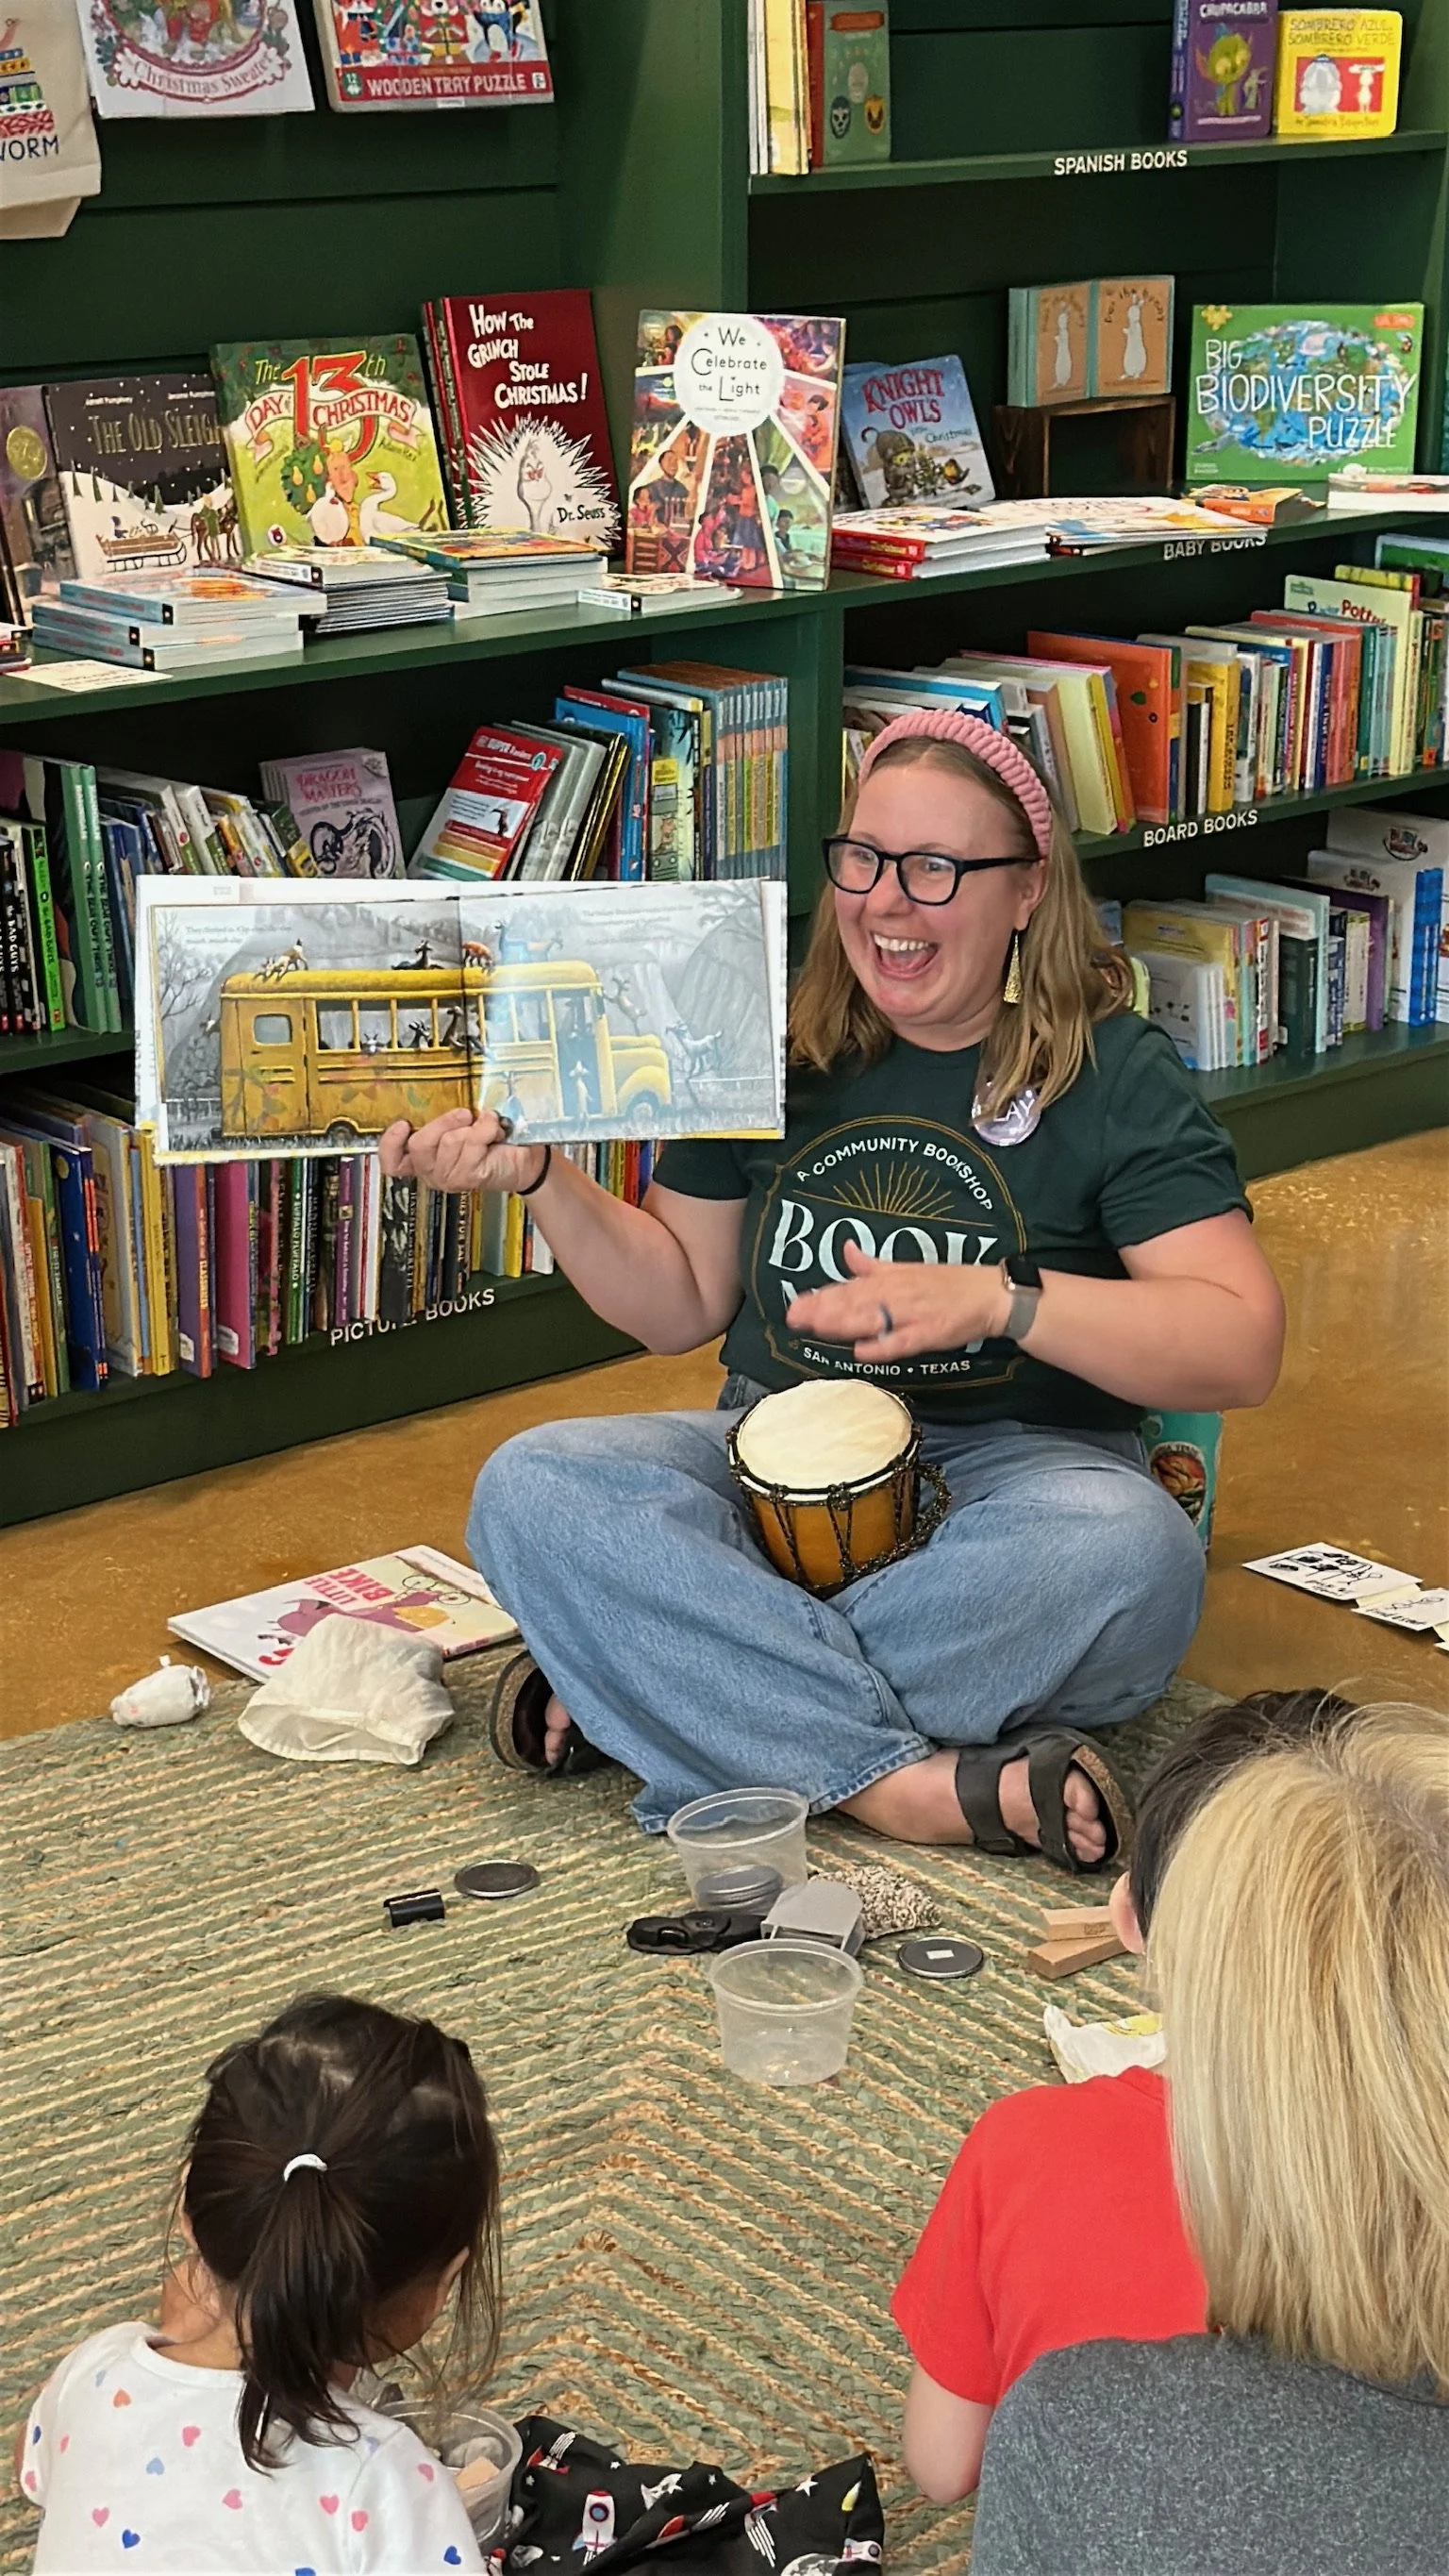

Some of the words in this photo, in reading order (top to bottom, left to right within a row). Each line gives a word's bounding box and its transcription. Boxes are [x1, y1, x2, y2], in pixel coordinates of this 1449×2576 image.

[1288, 32, 1352, 46] SOMBRERO
[1352, 31, 1396, 45] VERDE
[1291, 17, 1356, 31] SOMBRERO
[134, 60, 218, 93] Christmas
[367, 76, 432, 96] WOODEN
[433, 75, 471, 95] TRAY
[474, 73, 527, 93] PUZZLE
[1055, 154, 1125, 176] SPANISH
[1131, 150, 1188, 170] BOOKS
[718, 326, 746, 347] We
[468, 339, 519, 368] GRINCH
[691, 348, 767, 376] Celebrate
[1205, 339, 1242, 371] BIG
[255, 359, 280, 385] The
[509, 361, 550, 382] STOLE
[494, 372, 588, 410] CHRISTMAS!
[699, 382, 713, 392] the
[719, 376, 760, 401] Light
[861, 368, 945, 413] KNIGHT
[1195, 373, 1417, 415] BIODIVERSITY
[248, 394, 285, 429] DAY
[312, 390, 411, 427] CHRISTMAS
[88, 415, 126, 455] THE
[128, 412, 162, 452] OLD
[1308, 416, 1398, 449] PUZZLE
[557, 507, 575, 523] Dr.
[577, 504, 607, 521] Seuss
[1163, 540, 1206, 560] BABY
[295, 766, 357, 786] DRAGON
[300, 782, 363, 802] MASTERS
[1142, 821, 1198, 847] BOARD
[1204, 809, 1258, 835] BOOKS
[8, 919, 17, 943] BAD
[9, 944, 20, 973] GUYS
[796, 1170, 810, 1182] A
[812, 1136, 920, 1177] COMMUNITY
[923, 1142, 993, 1212] BOOKSHOP
[767, 1198, 999, 1283] BOOK
[803, 1347, 830, 1365] SAN
[834, 1359, 902, 1377] ANTONIO
[920, 1359, 972, 1376] TEXAS
[304, 1576, 358, 1605] LITTLE
[330, 1567, 398, 1602] BIKE
